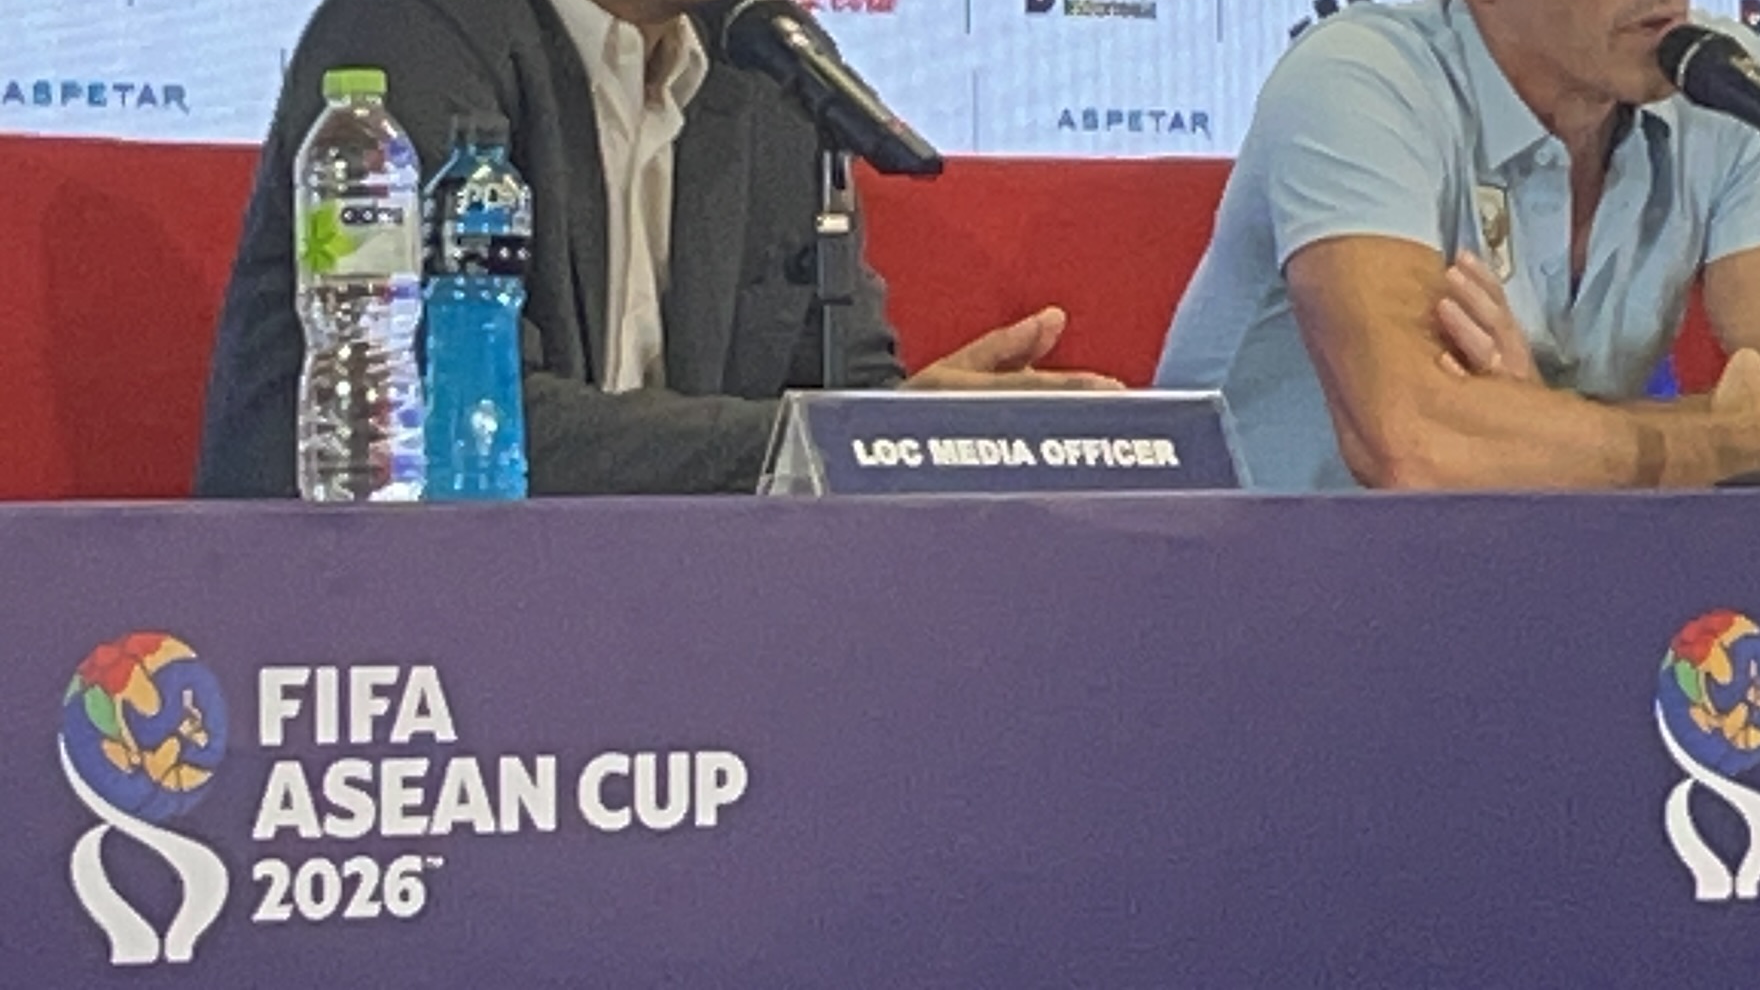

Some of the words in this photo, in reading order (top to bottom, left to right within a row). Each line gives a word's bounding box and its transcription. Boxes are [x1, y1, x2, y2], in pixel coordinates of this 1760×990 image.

[2, 80, 189, 114] ASPETAR
[1058, 108, 1211, 139] ASPETAR
[853, 438, 923, 467] LOC
[927, 438, 1037, 466] MEDIA
[1040, 438, 1179, 467] OFFICER
[258, 665, 457, 746] FIFA
[252, 756, 556, 840] ASEAN
[577, 751, 748, 831] CUP
